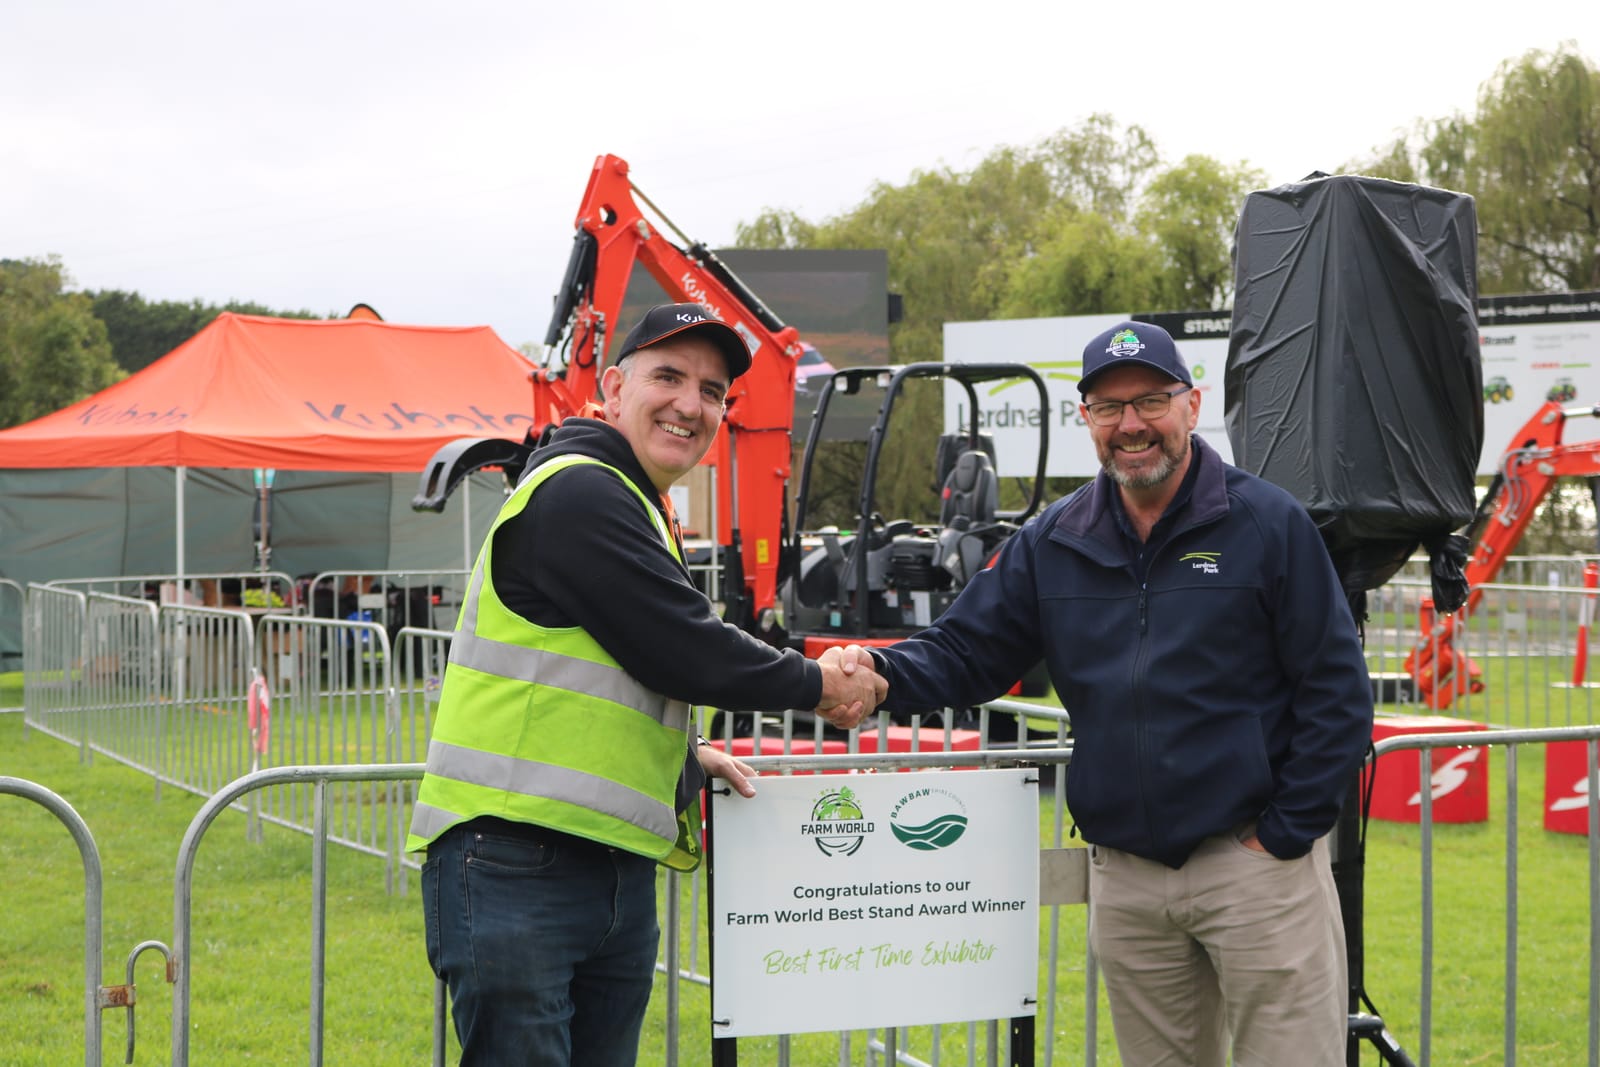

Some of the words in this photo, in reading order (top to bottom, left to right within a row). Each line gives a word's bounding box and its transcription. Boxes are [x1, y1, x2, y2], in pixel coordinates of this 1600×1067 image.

[801, 824, 833, 835] FARM
[835, 822, 875, 834] WORLD
[793, 881, 922, 901] Congratulations
[925, 881, 942, 893] to
[945, 879, 972, 892] our
[726, 912, 769, 925] Farm
[774, 908, 824, 924] World
[828, 907, 864, 921] Best
[868, 904, 914, 919] Stand
[918, 901, 967, 917] Award
[971, 898, 1027, 913] Winner
[763, 949, 811, 975] Best
[816, 947, 865, 972] First
[870, 944, 914, 969] Time
[921, 938, 999, 967] Exhibitor
